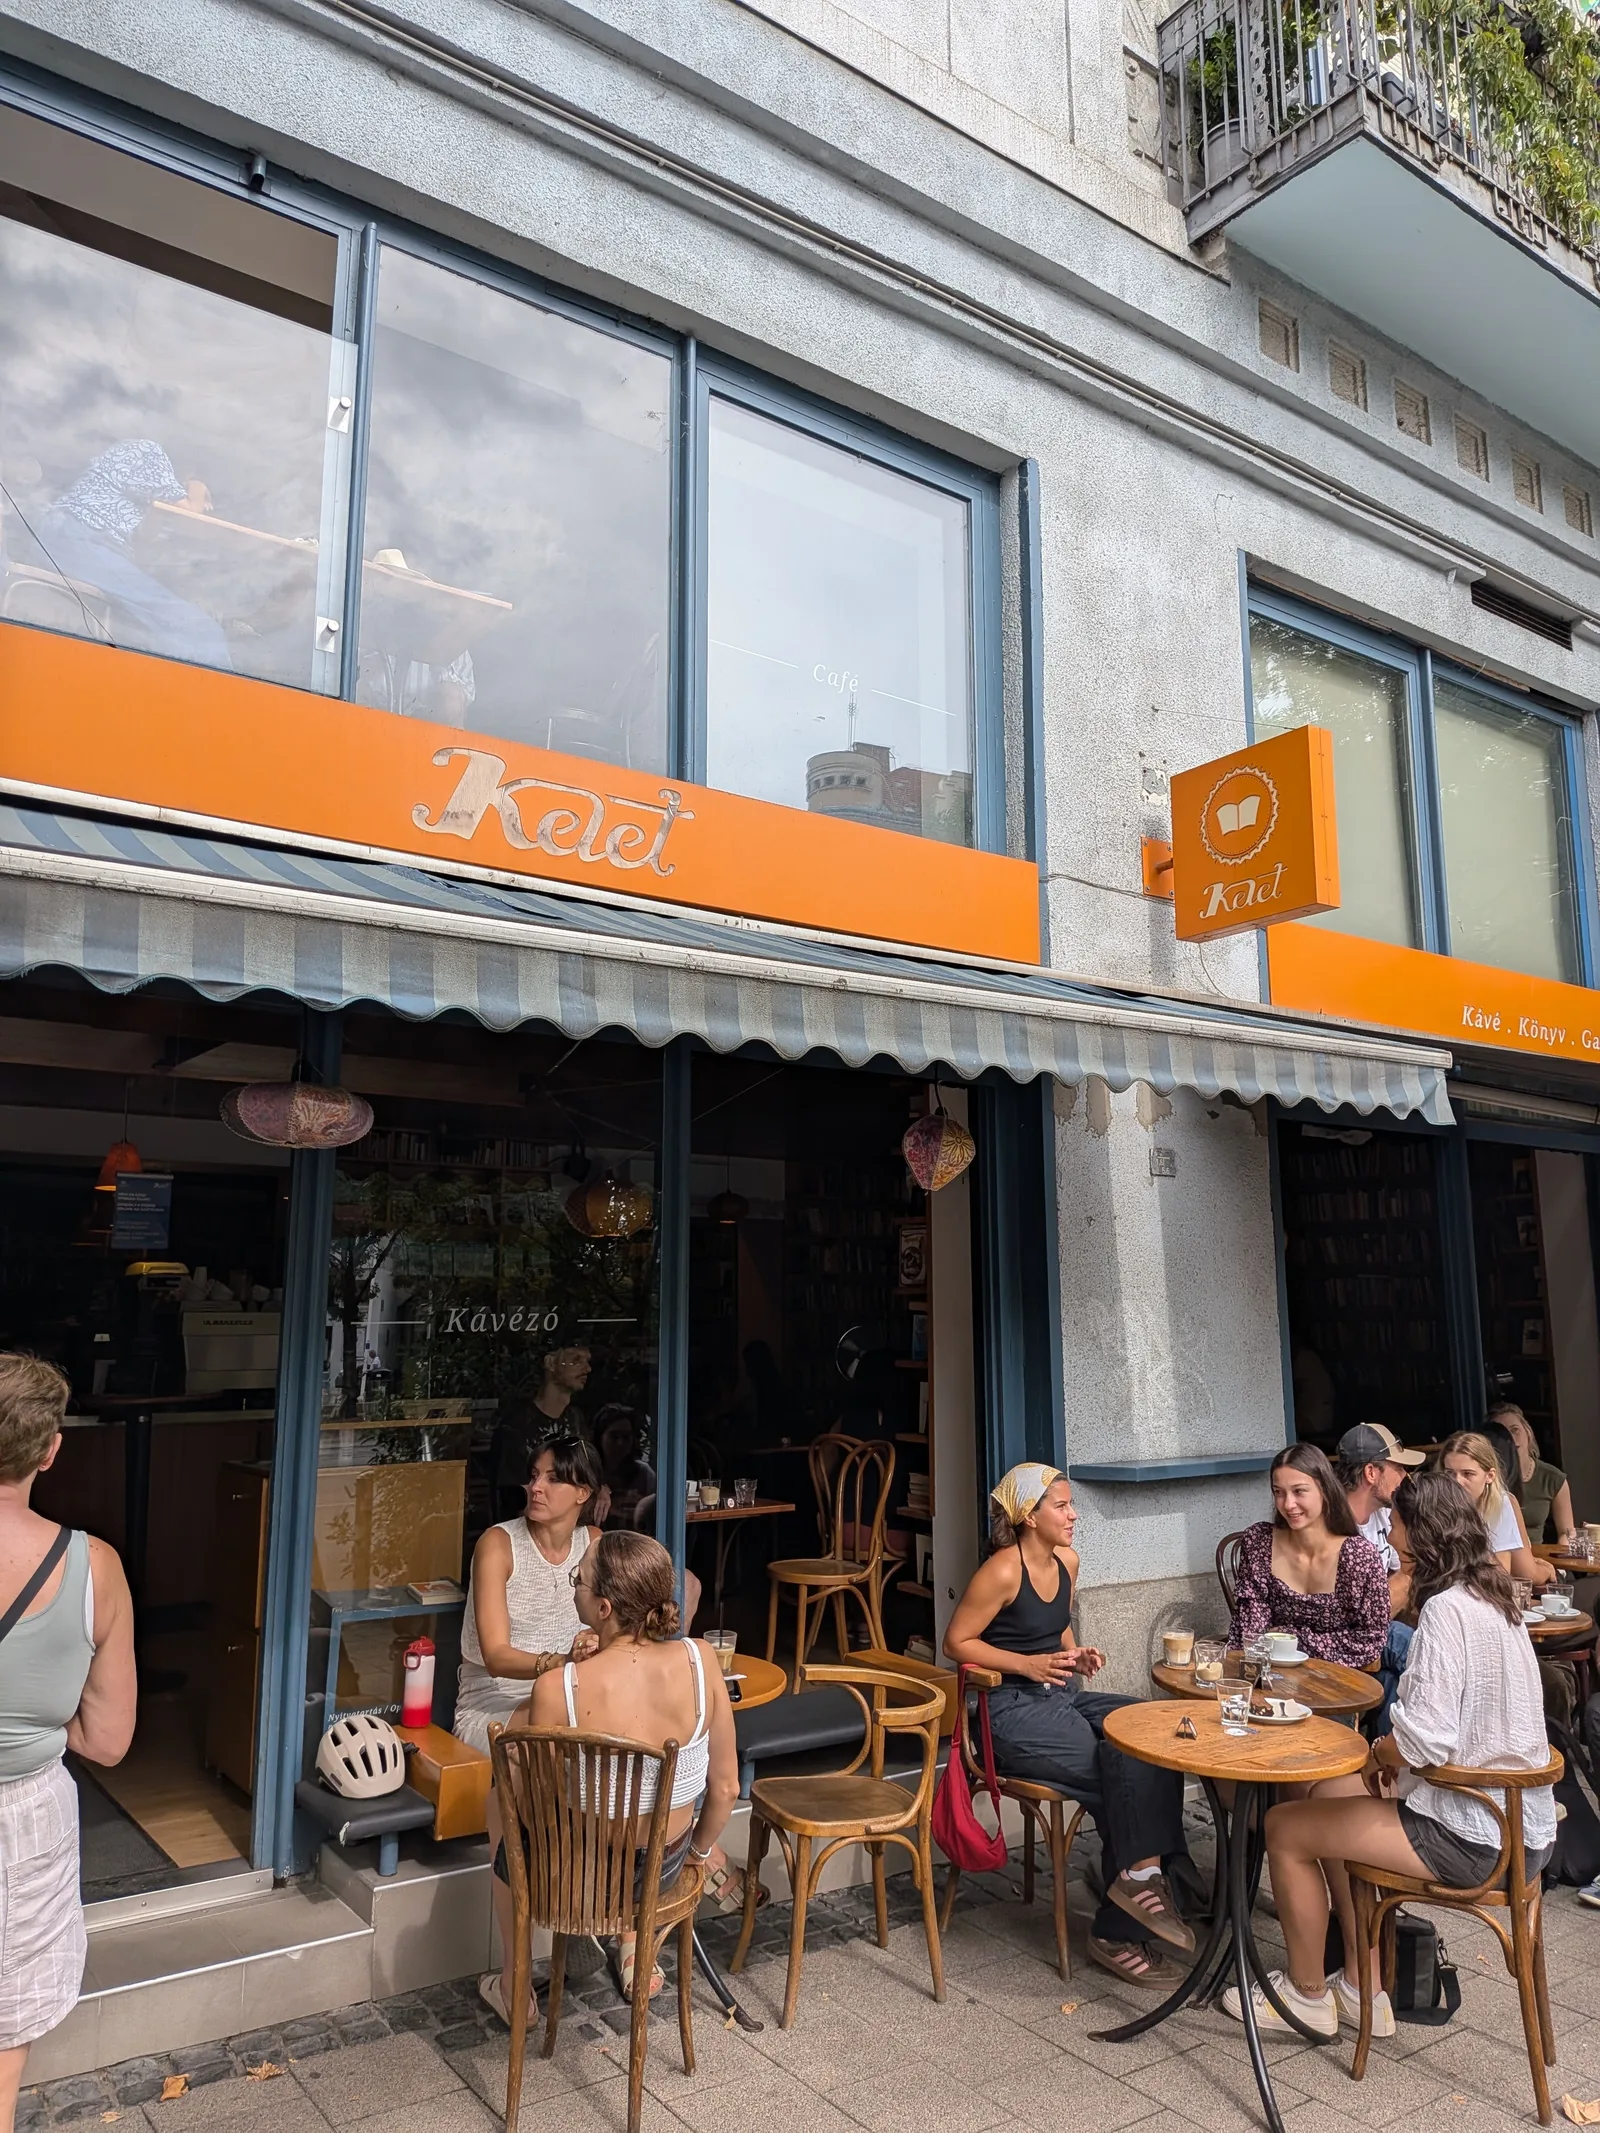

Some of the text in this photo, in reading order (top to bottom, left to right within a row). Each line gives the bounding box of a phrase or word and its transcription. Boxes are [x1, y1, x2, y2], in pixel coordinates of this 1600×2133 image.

[812, 663, 859, 693] Café
[411, 747, 696, 877] Kelet
[1199, 862, 1288, 919] Kelet
[1461, 1005, 1501, 1031] Kávé
[1518, 1016, 1566, 1046] Könyv
[1581, 1029, 1600, 1050] Ga
[444, 1306, 559, 1333] Kávézó
